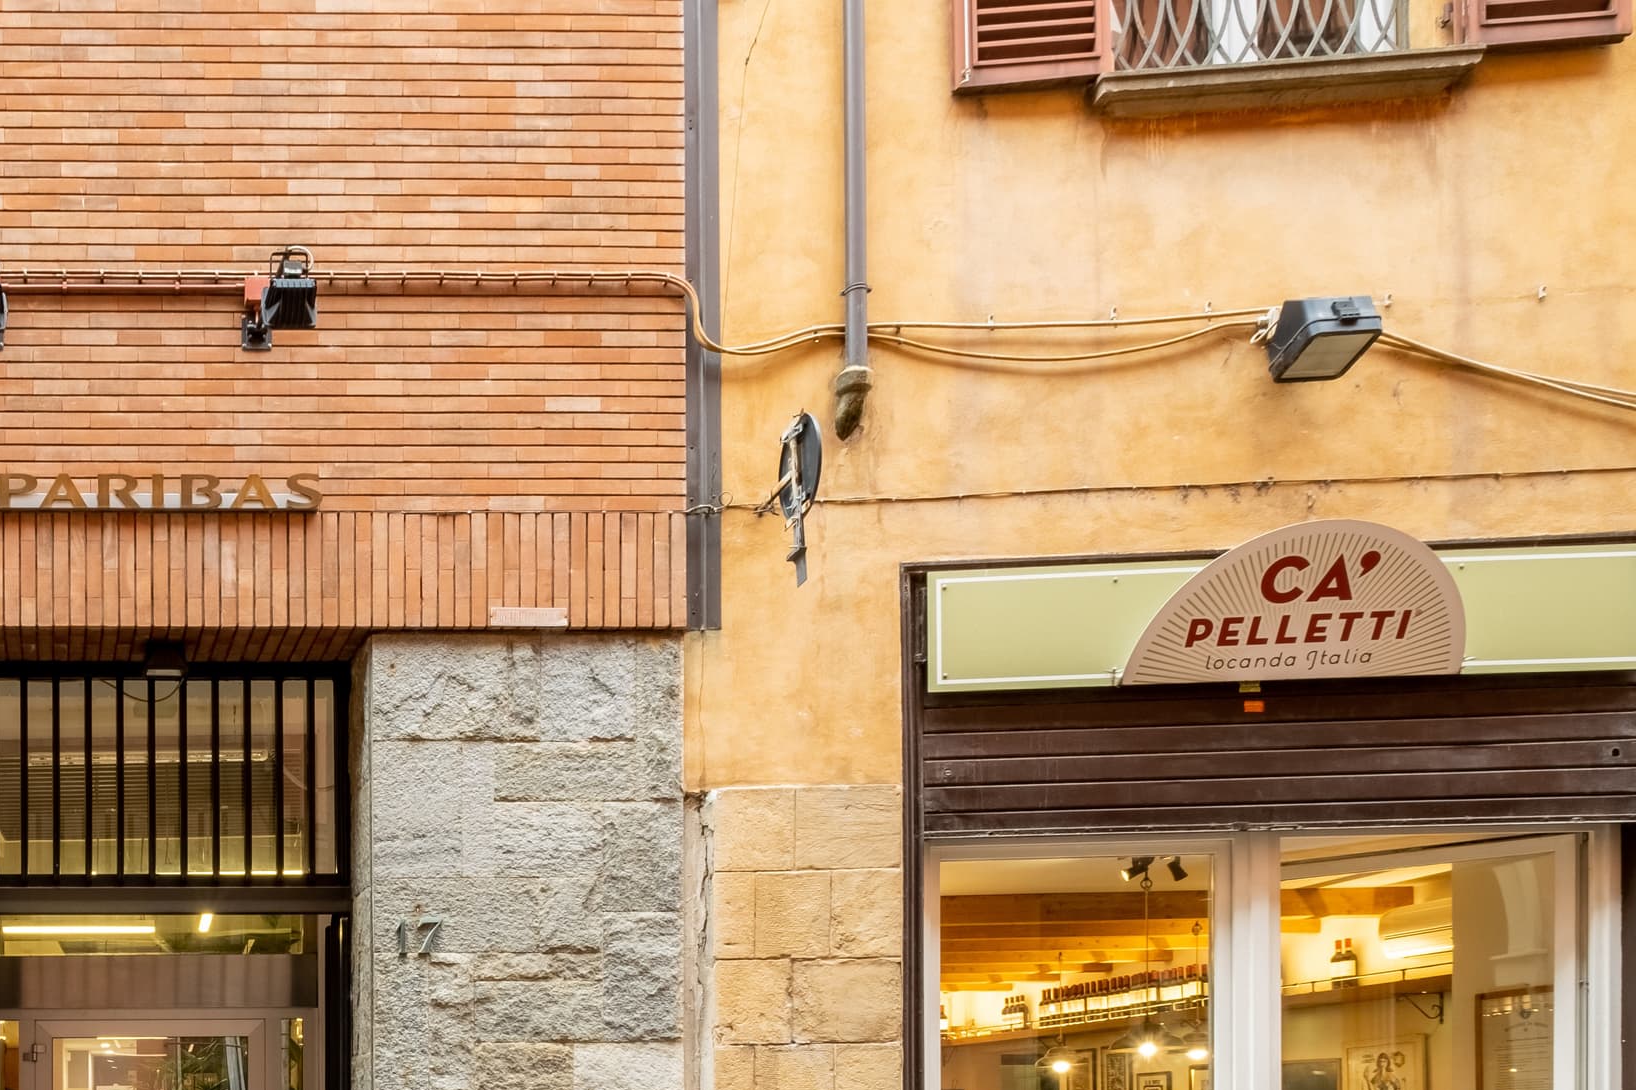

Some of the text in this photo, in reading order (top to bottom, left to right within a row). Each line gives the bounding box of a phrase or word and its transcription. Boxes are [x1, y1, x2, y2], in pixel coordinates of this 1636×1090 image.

[1184, 609, 1413, 648] PELLETTI
[1205, 648, 1373, 671] locanda Italia
[395, 916, 443, 957] 17
